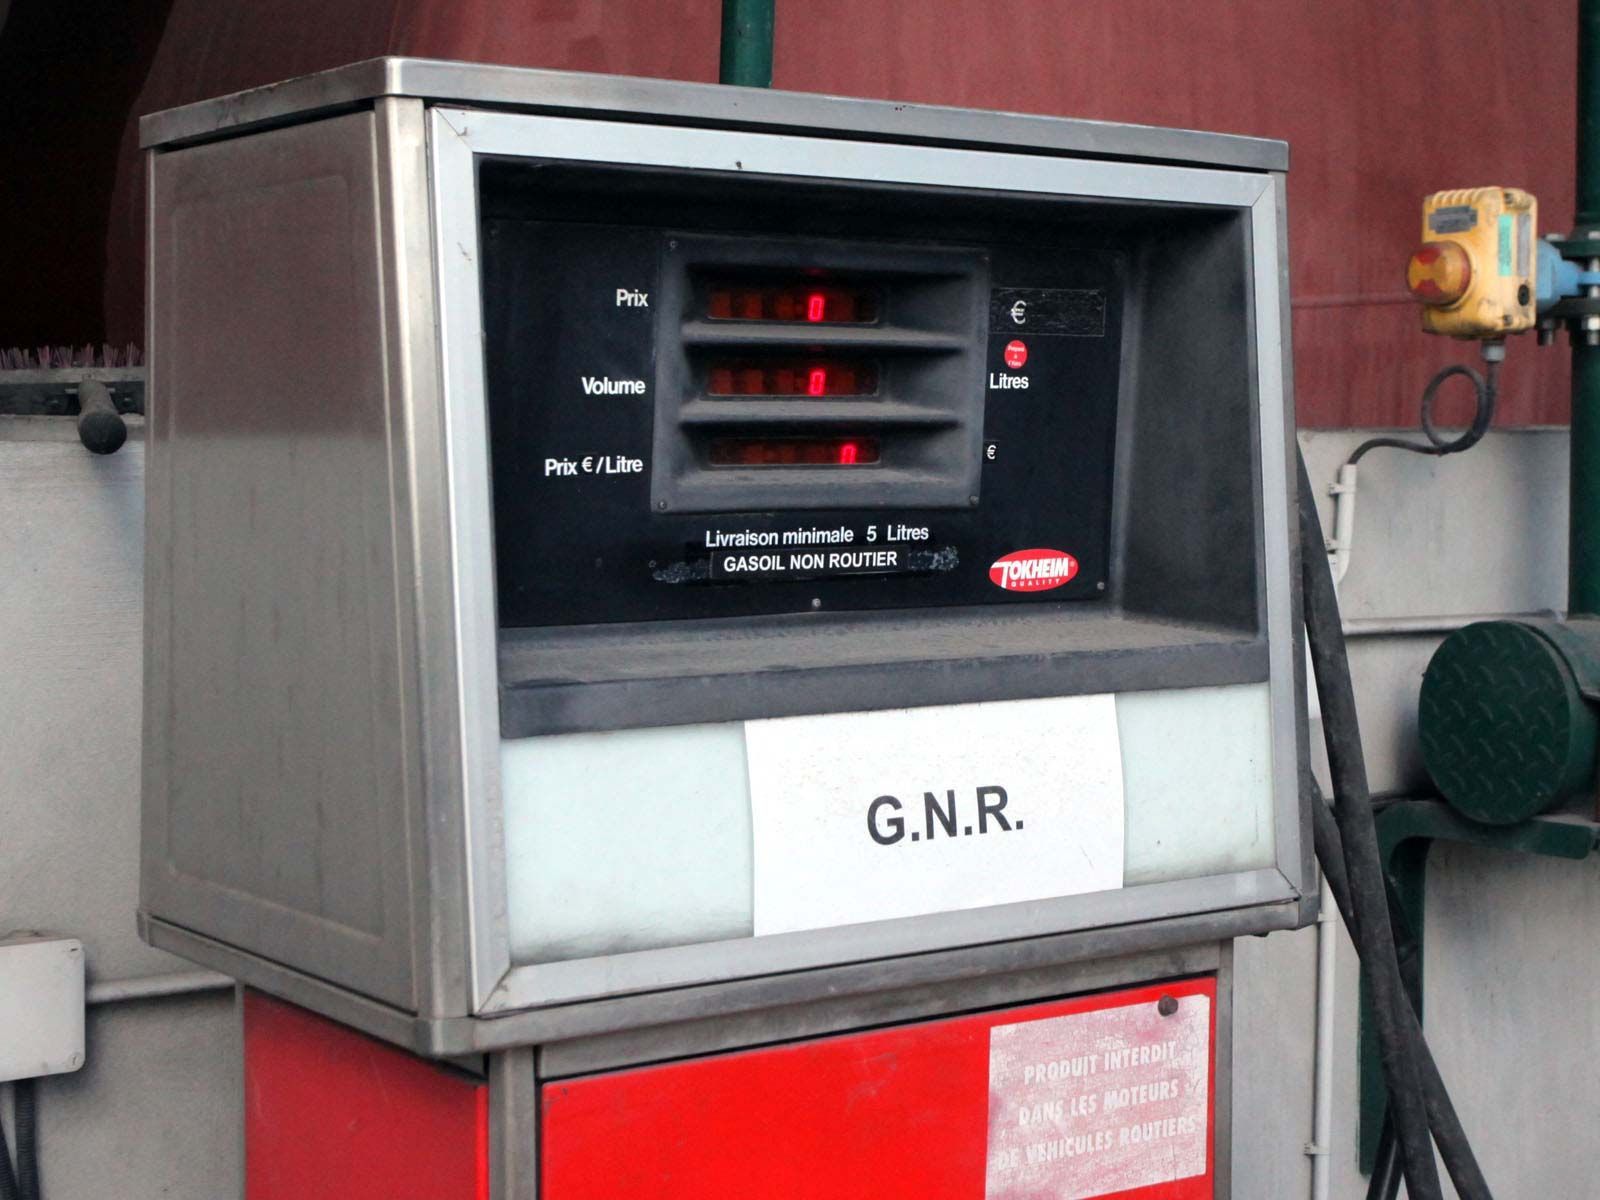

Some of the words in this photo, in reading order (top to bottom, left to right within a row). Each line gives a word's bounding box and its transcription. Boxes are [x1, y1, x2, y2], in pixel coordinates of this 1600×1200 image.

[616, 288, 649, 307] Prix
[808, 294, 825, 322] 0
[1010, 299, 1028, 325] €
[581, 376, 647, 395] Volume
[809, 368, 826, 397] 0
[989, 372, 1030, 390] Litres
[986, 444, 998, 461] €
[544, 457, 579, 477] Prix
[705, 530, 779, 548] Livraison
[782, 526, 855, 545] minimale
[866, 525, 878, 543] 5
[886, 524, 929, 542] Litres
[723, 555, 786, 573] GASOIL
[789, 553, 826, 570] NON
[828, 551, 898, 569] ROUTIER
[990, 557, 1070, 589] TOKHEIM
[1010, 578, 1061, 588] QUALITY
[866, 785, 1024, 846] G.N.R.
[1023, 1053, 1099, 1086] PRODUIT
[1103, 1040, 1178, 1072] INTERDIT
[1018, 1101, 1064, 1127] DANS
[1070, 1095, 1097, 1118] LES
[1102, 1078, 1180, 1110] MOTEURS
[1119, 1115, 1198, 1147] ROUTIERS
